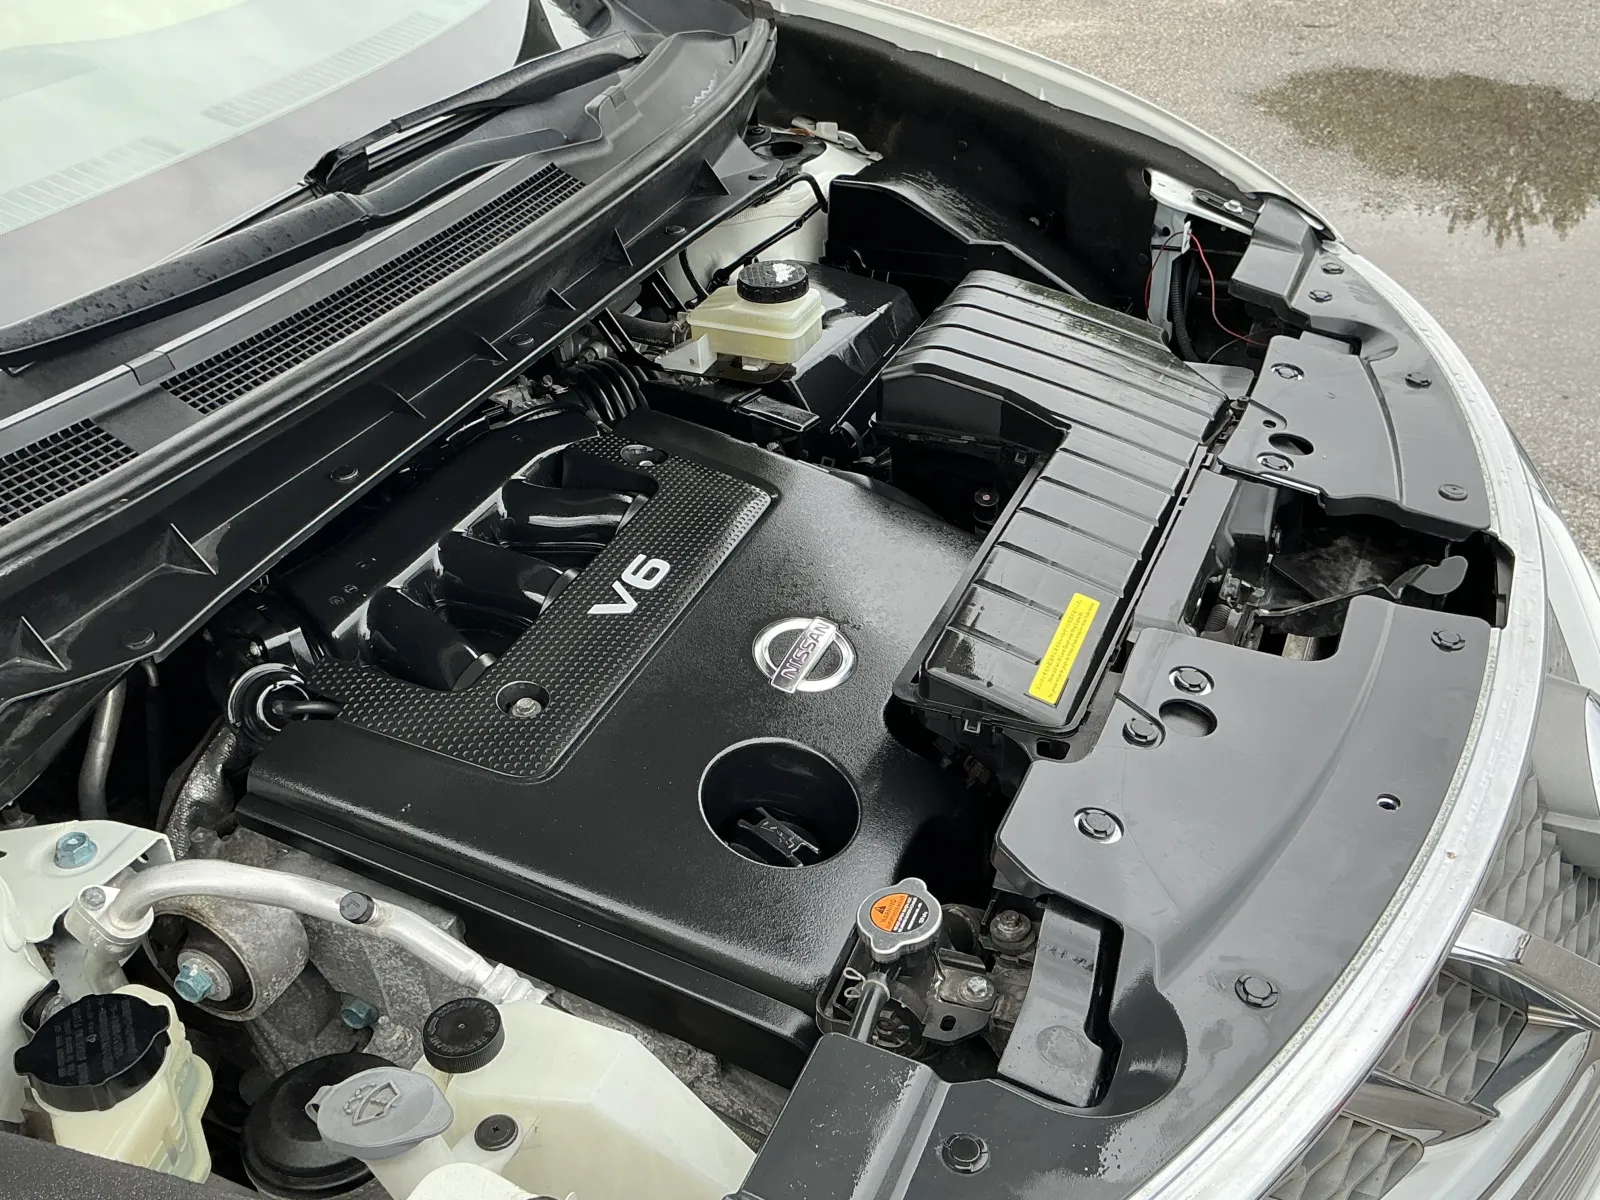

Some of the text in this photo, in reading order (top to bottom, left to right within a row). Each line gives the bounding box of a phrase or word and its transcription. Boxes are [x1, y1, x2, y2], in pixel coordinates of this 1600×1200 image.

[587, 553, 671, 615] V6
[780, 622, 831, 680] NISSAN
[880, 899, 896, 923] WARNING
